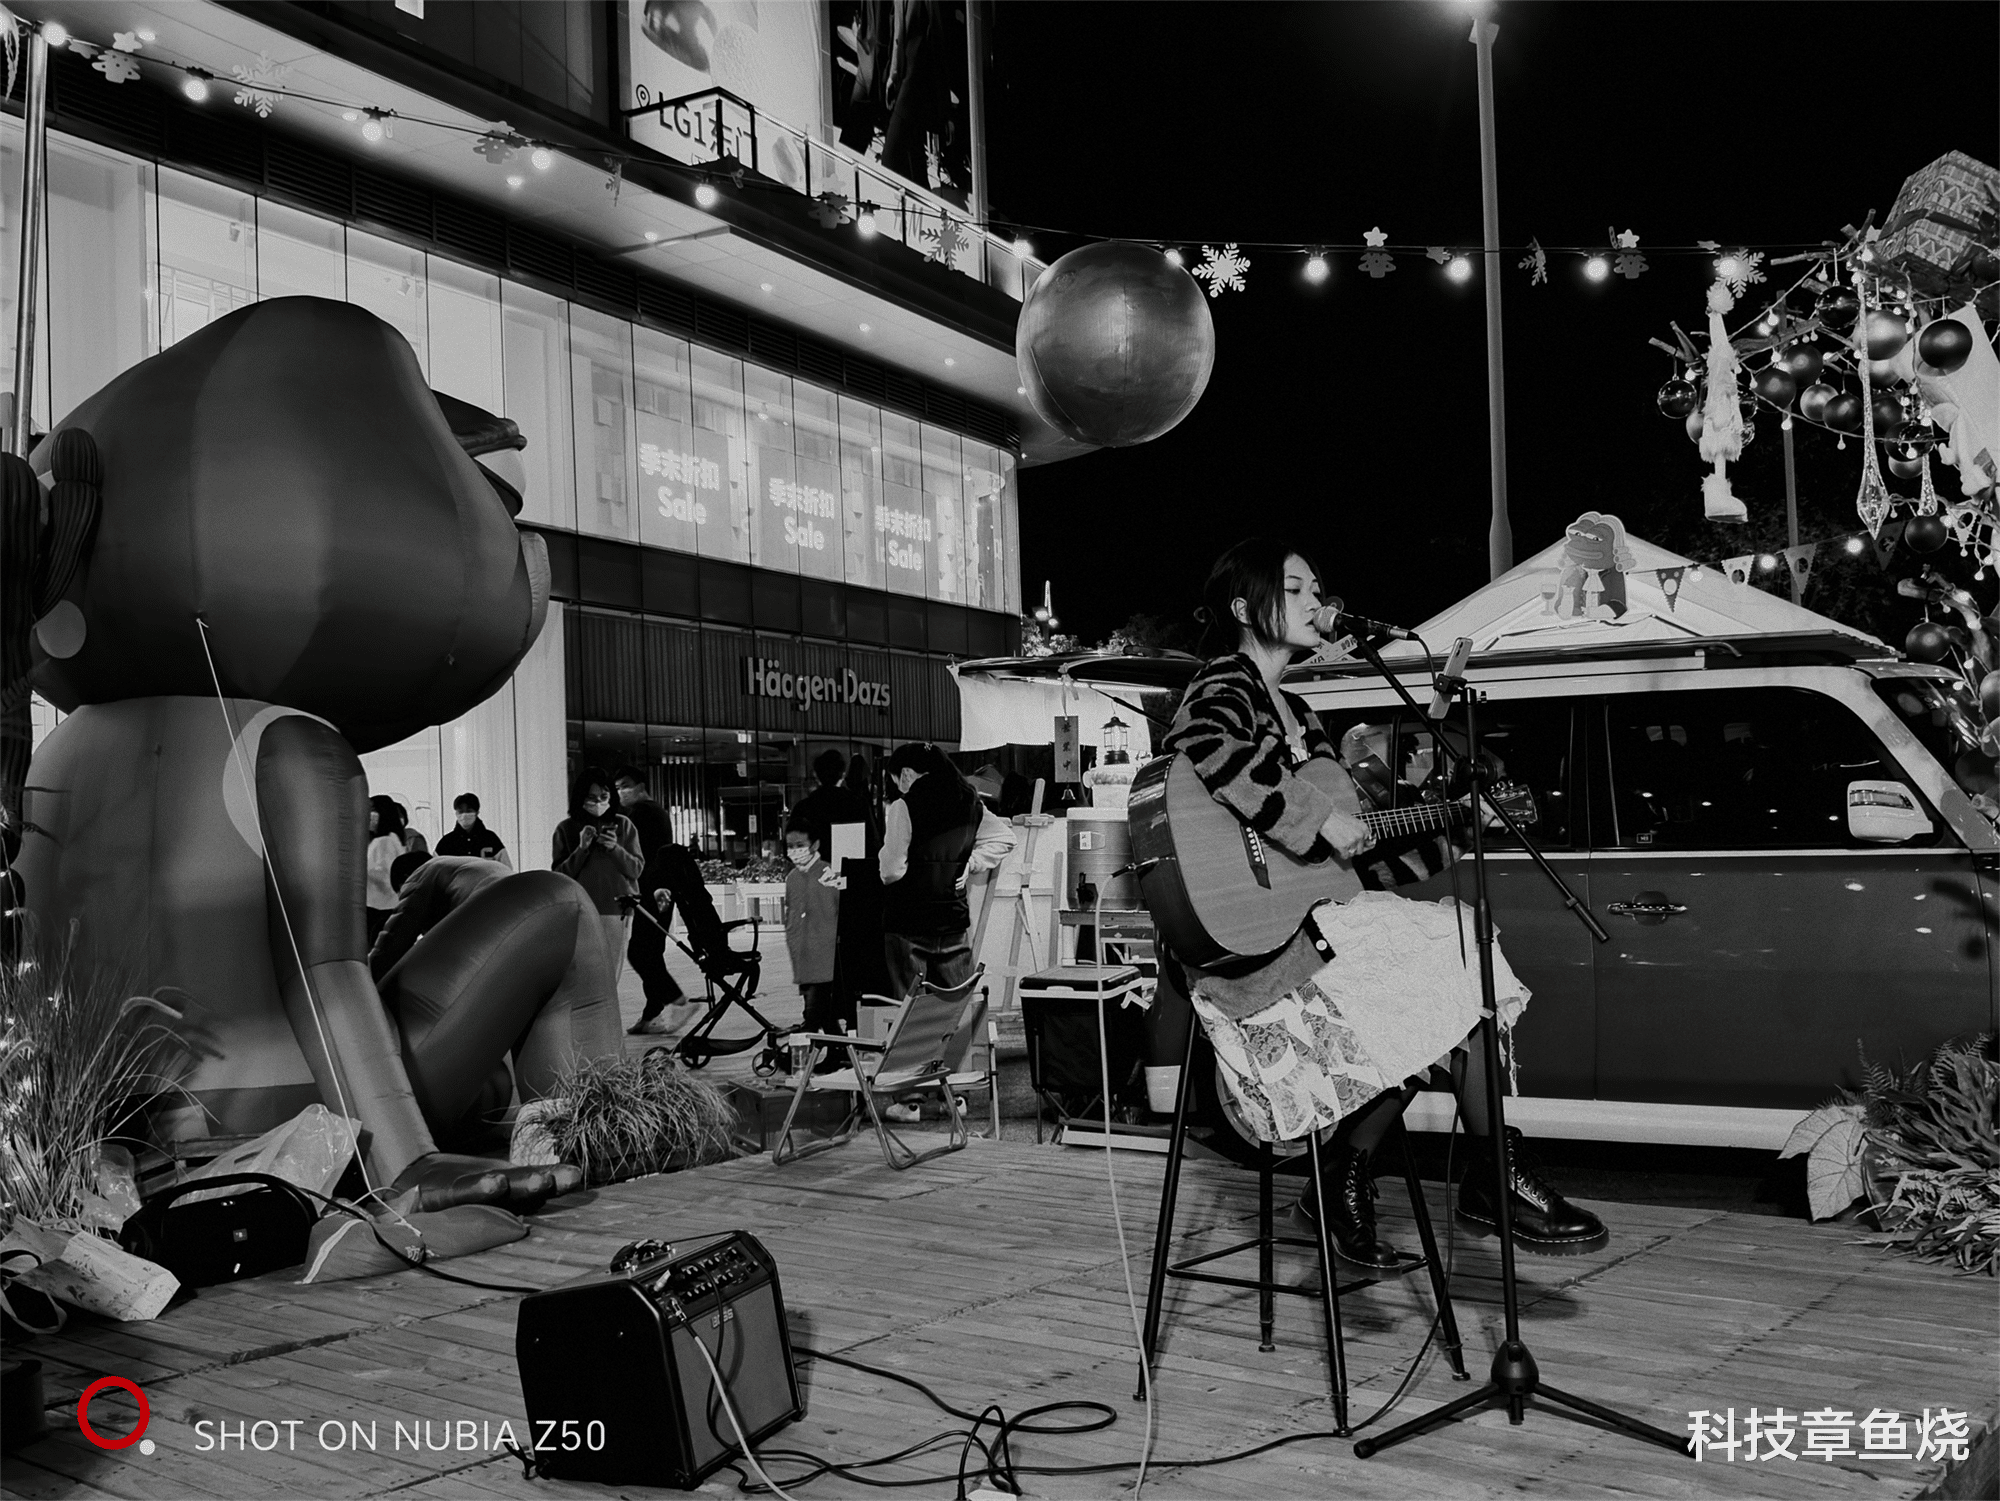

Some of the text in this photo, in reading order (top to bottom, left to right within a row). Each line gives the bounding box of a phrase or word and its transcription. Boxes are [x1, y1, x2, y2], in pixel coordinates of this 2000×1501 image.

[640, 443, 719, 491] 季末折扣
[658, 486, 706, 524] Sale
[769, 478, 834, 519] 季末折扣
[784, 516, 824, 550] Sale
[875, 505, 931, 542] 季末折扣
[888, 540, 922, 570] Sale
